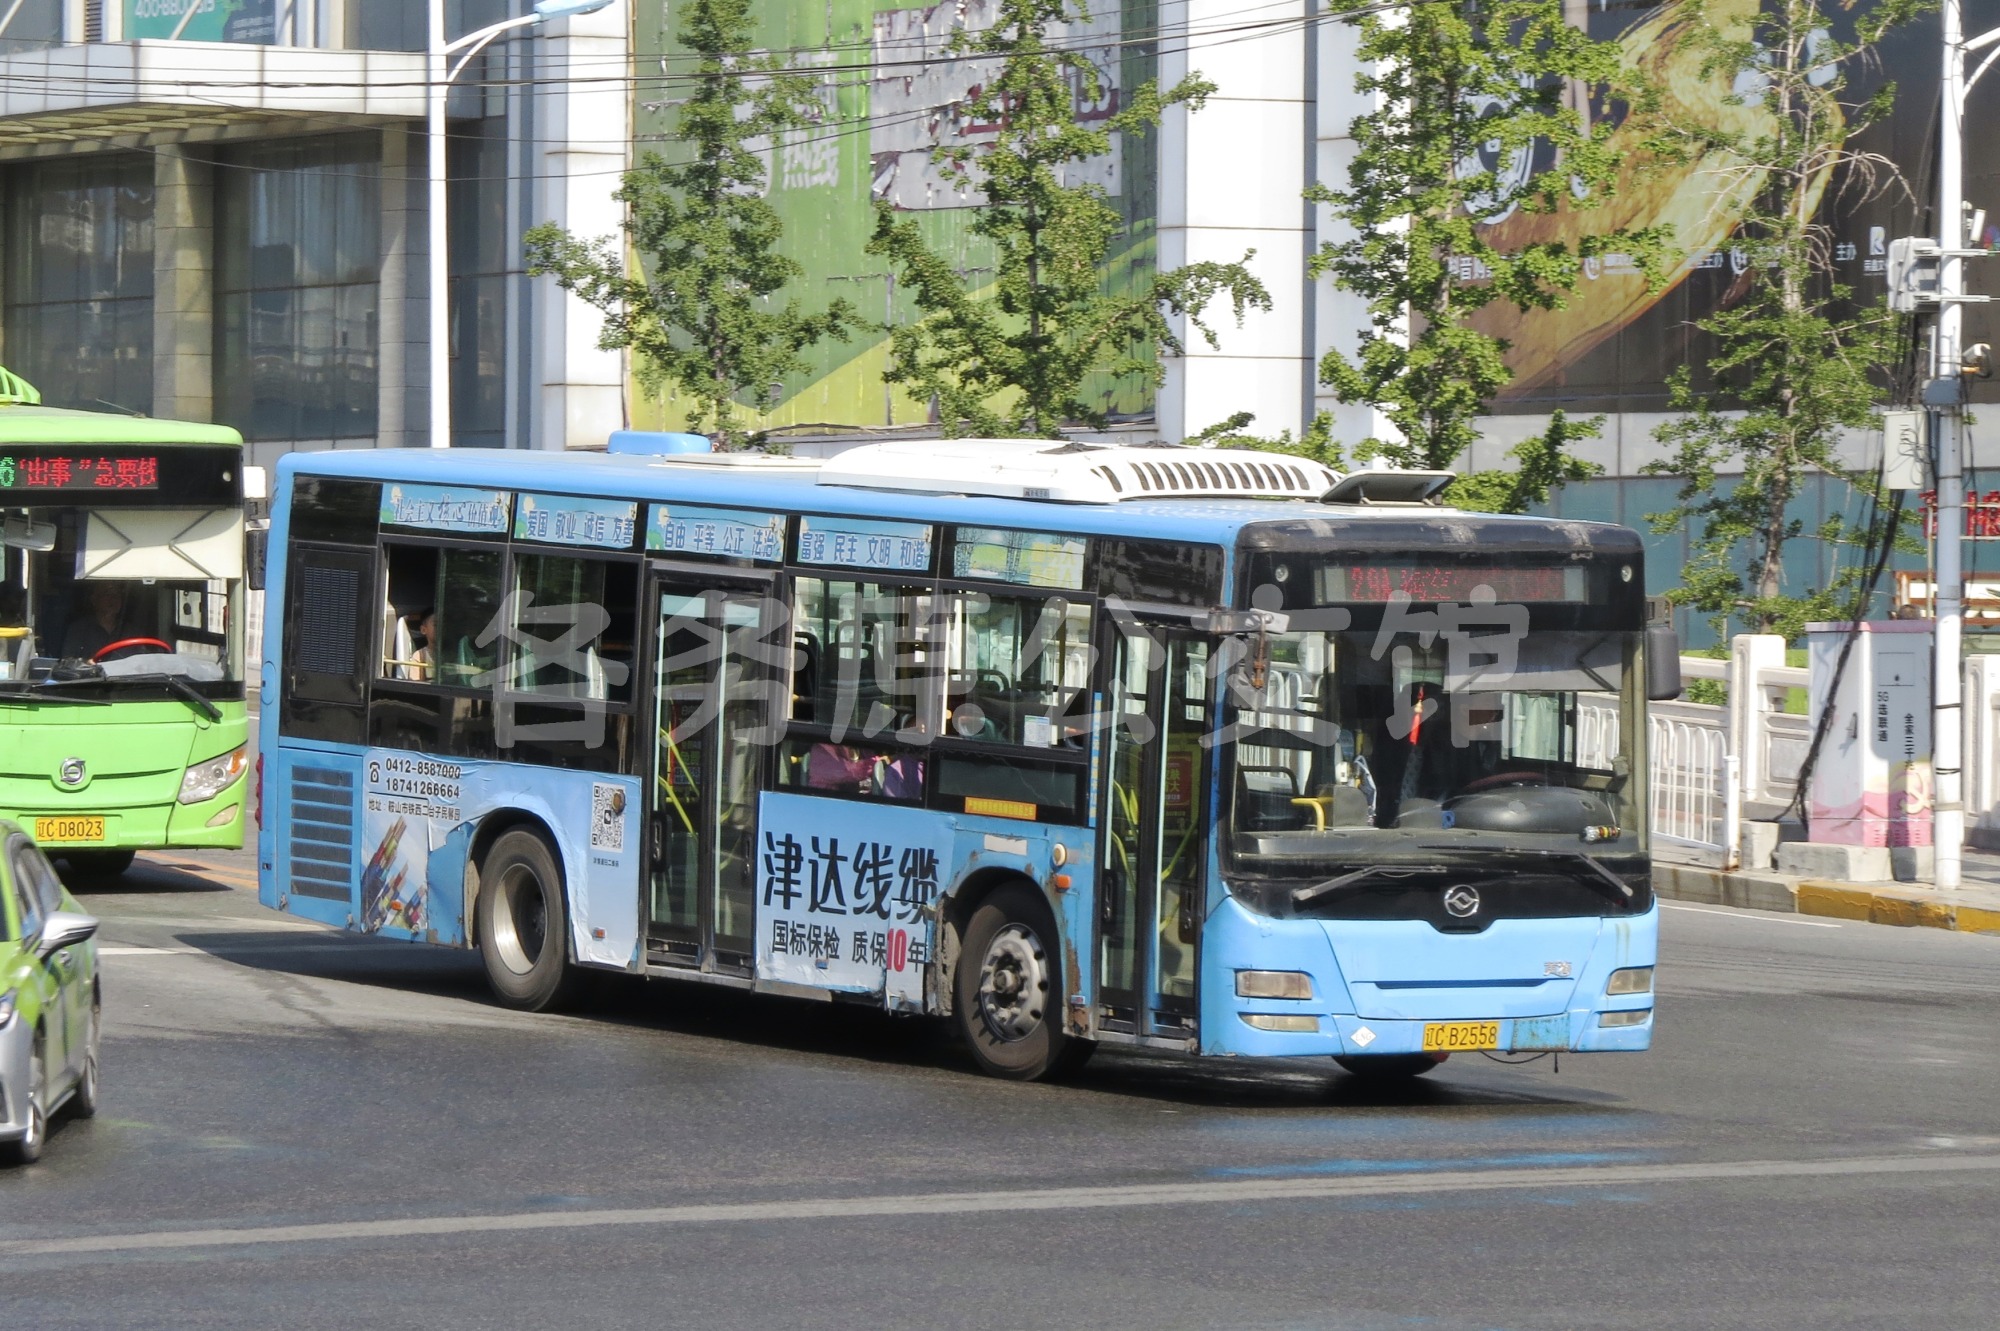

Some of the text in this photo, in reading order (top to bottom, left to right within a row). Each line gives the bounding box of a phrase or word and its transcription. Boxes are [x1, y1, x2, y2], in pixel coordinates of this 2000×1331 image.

[528, 510, 634, 544] 爱国 敬业 诚信 友善
[665, 521, 774, 558] 自由 平等 公正 法治
[801, 532, 925, 568] 富强 民主 文明 和谐
[386, 758, 461, 779] 0412-8587000
[386, 777, 460, 798] 18741266664
[763, 831, 940, 925] 津达线缆
[771, 919, 927, 974] 国标保检 质保10年
